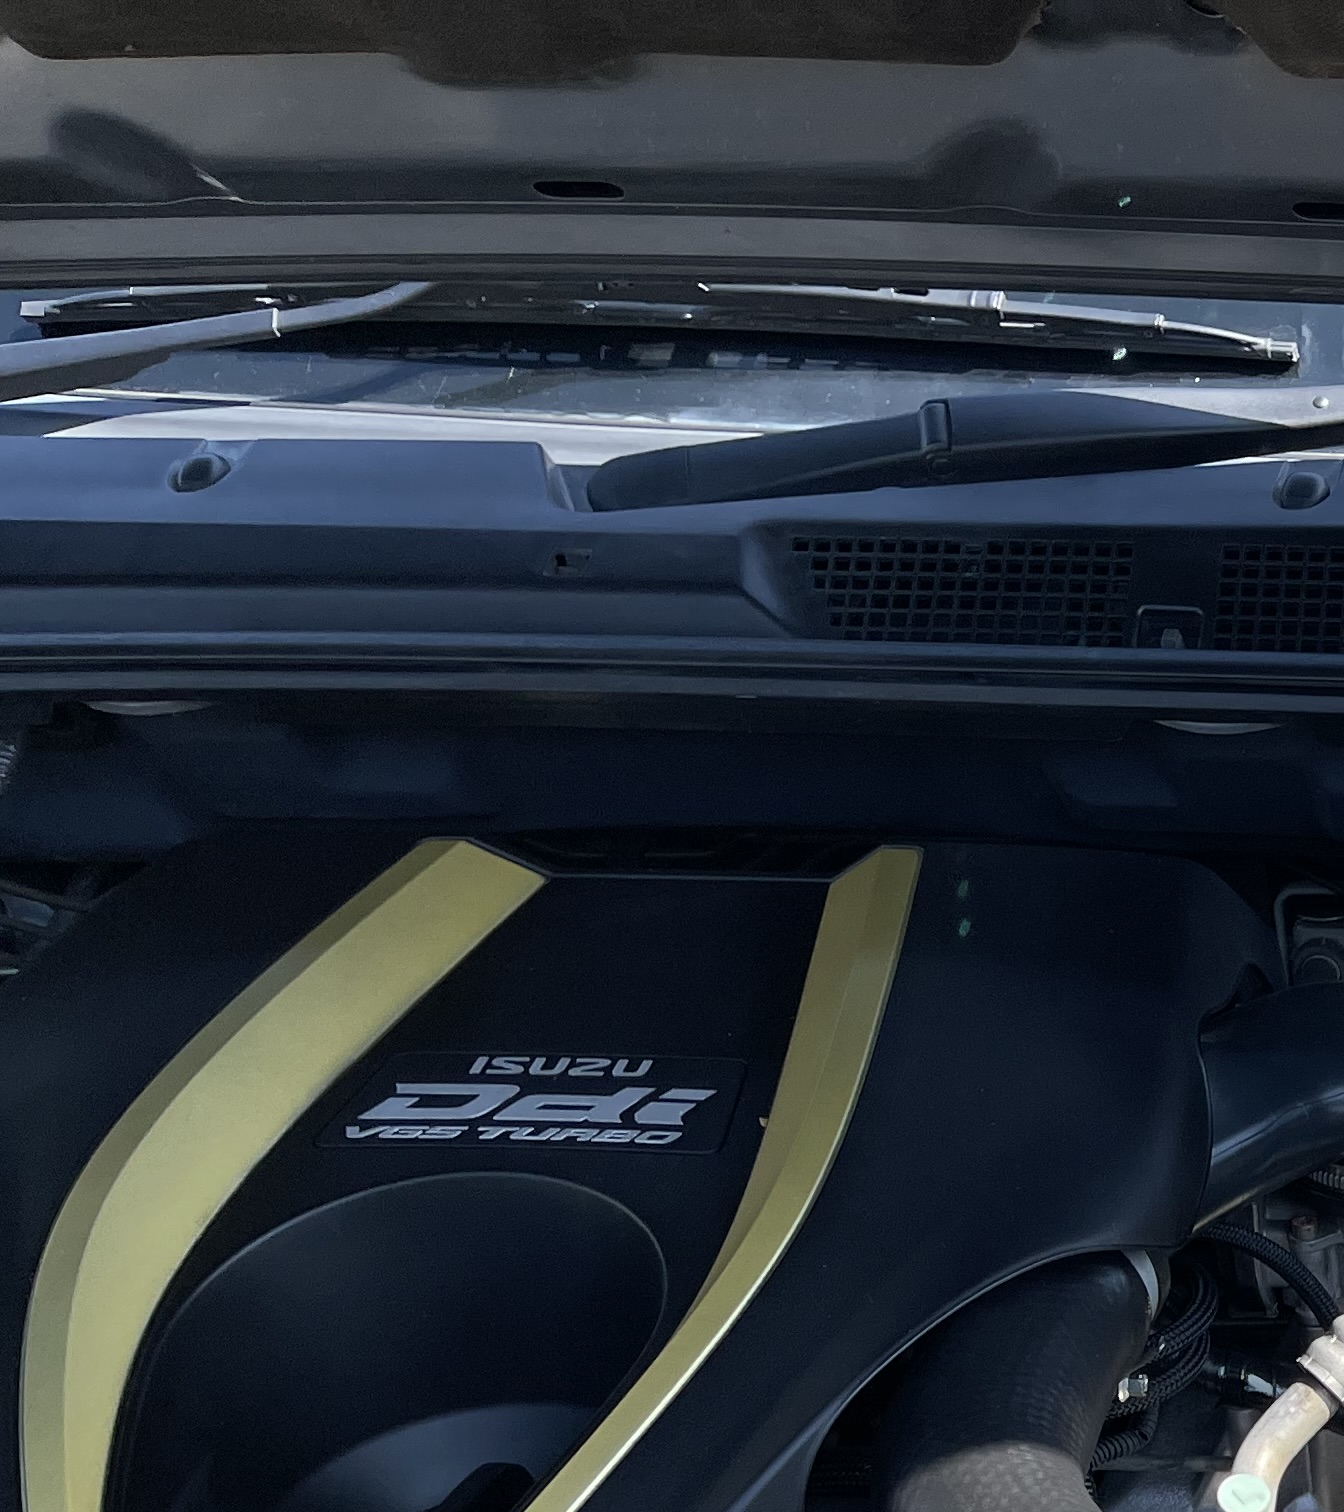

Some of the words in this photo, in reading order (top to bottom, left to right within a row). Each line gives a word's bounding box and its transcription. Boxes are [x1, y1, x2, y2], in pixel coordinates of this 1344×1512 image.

[468, 1056, 654, 1077] ISUZU
[345, 1125, 469, 1140] VGS
[477, 1126, 683, 1144] TURBO
